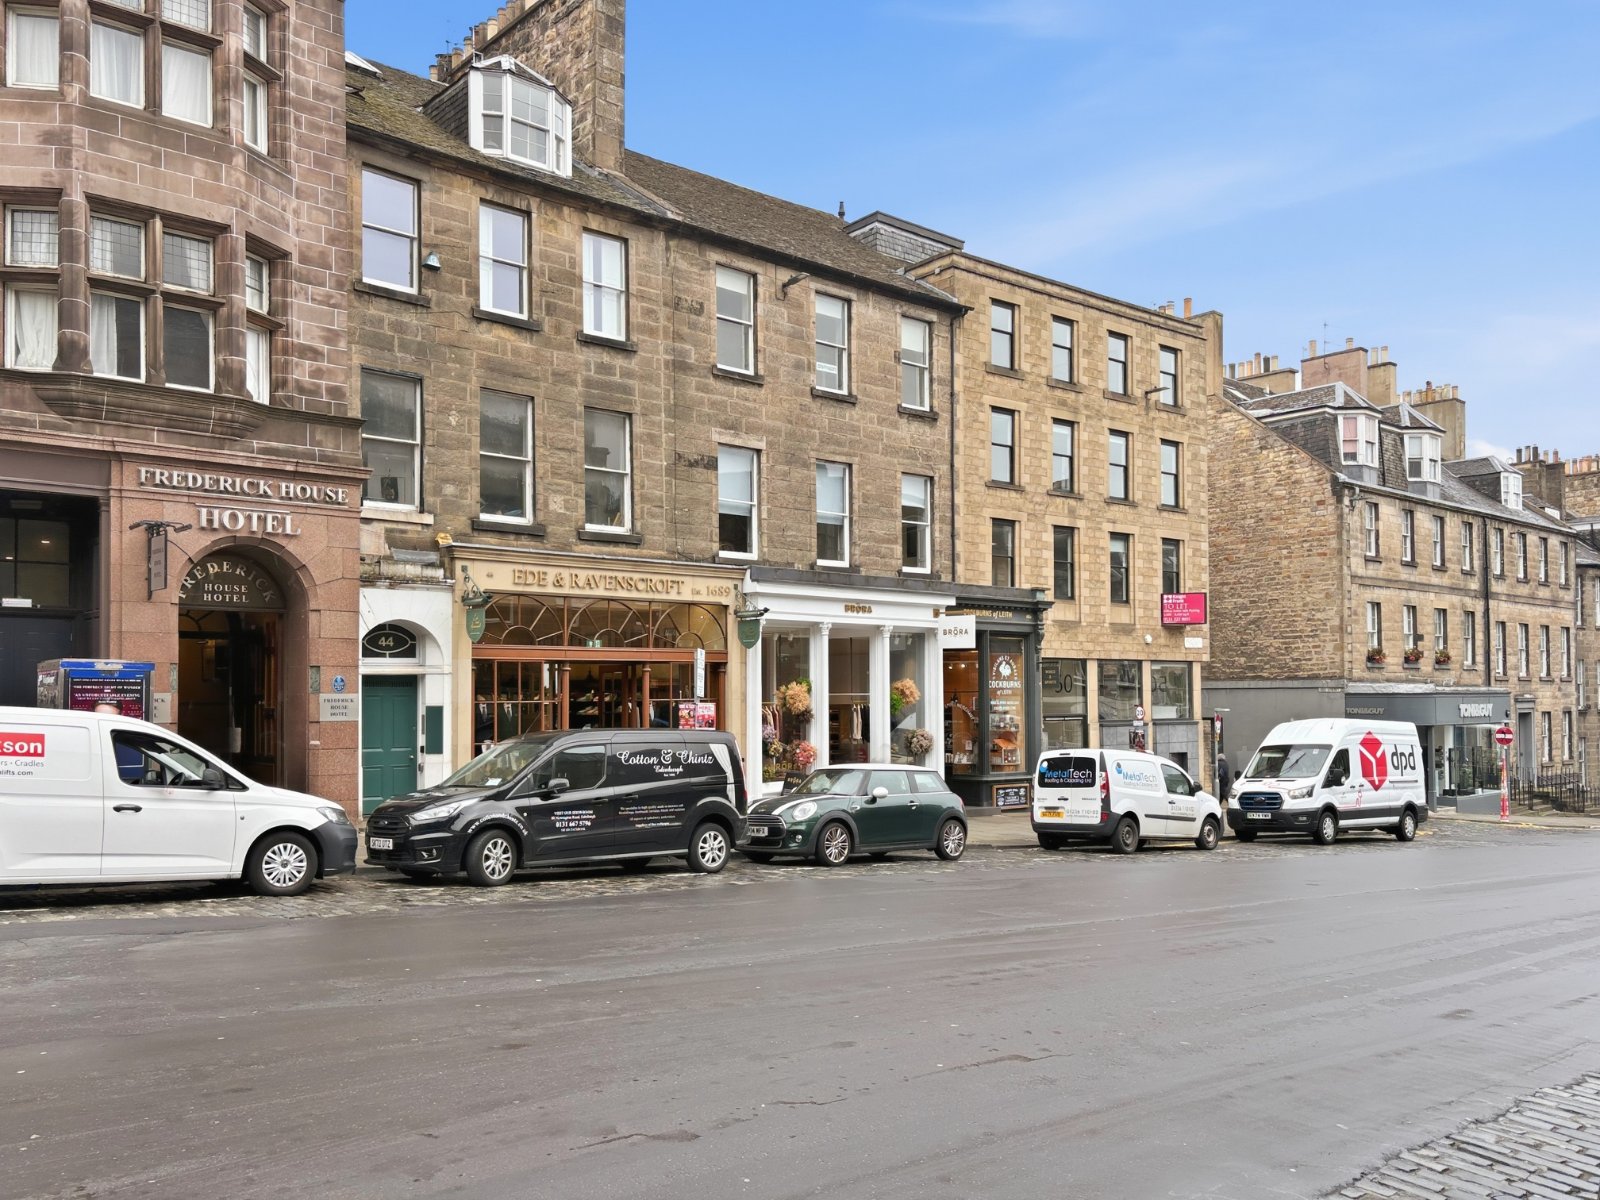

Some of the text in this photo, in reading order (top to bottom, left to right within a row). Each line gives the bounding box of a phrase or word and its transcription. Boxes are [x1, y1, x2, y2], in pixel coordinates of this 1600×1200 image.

[138, 467, 349, 503] FREDERICK HOUSE
[198, 507, 301, 536] HOTEL
[512, 568, 685, 595] EDE & RAVENSCROFT
[204, 583, 249, 593] HOUSE
[705, 584, 731, 598] 1689
[203, 593, 249, 603] HOTEL
[999, 611, 1013, 619] LEITH
[378, 636, 394, 647] 44
[989, 680, 1021, 689] COCKBURNS
[1345, 707, 1385, 715] TONI&GUY
[1458, 703, 1494, 718] TONI&GUY
[616, 749, 714, 765] Cotton & Chintz
[1391, 744, 1416, 777] dpd
[15, 760, 44, 768] Cradles
[653, 765, 684, 775] Edinburgh
[1045, 769, 1093, 778] MetalTech
[1122, 771, 1158, 783] MetalTech
